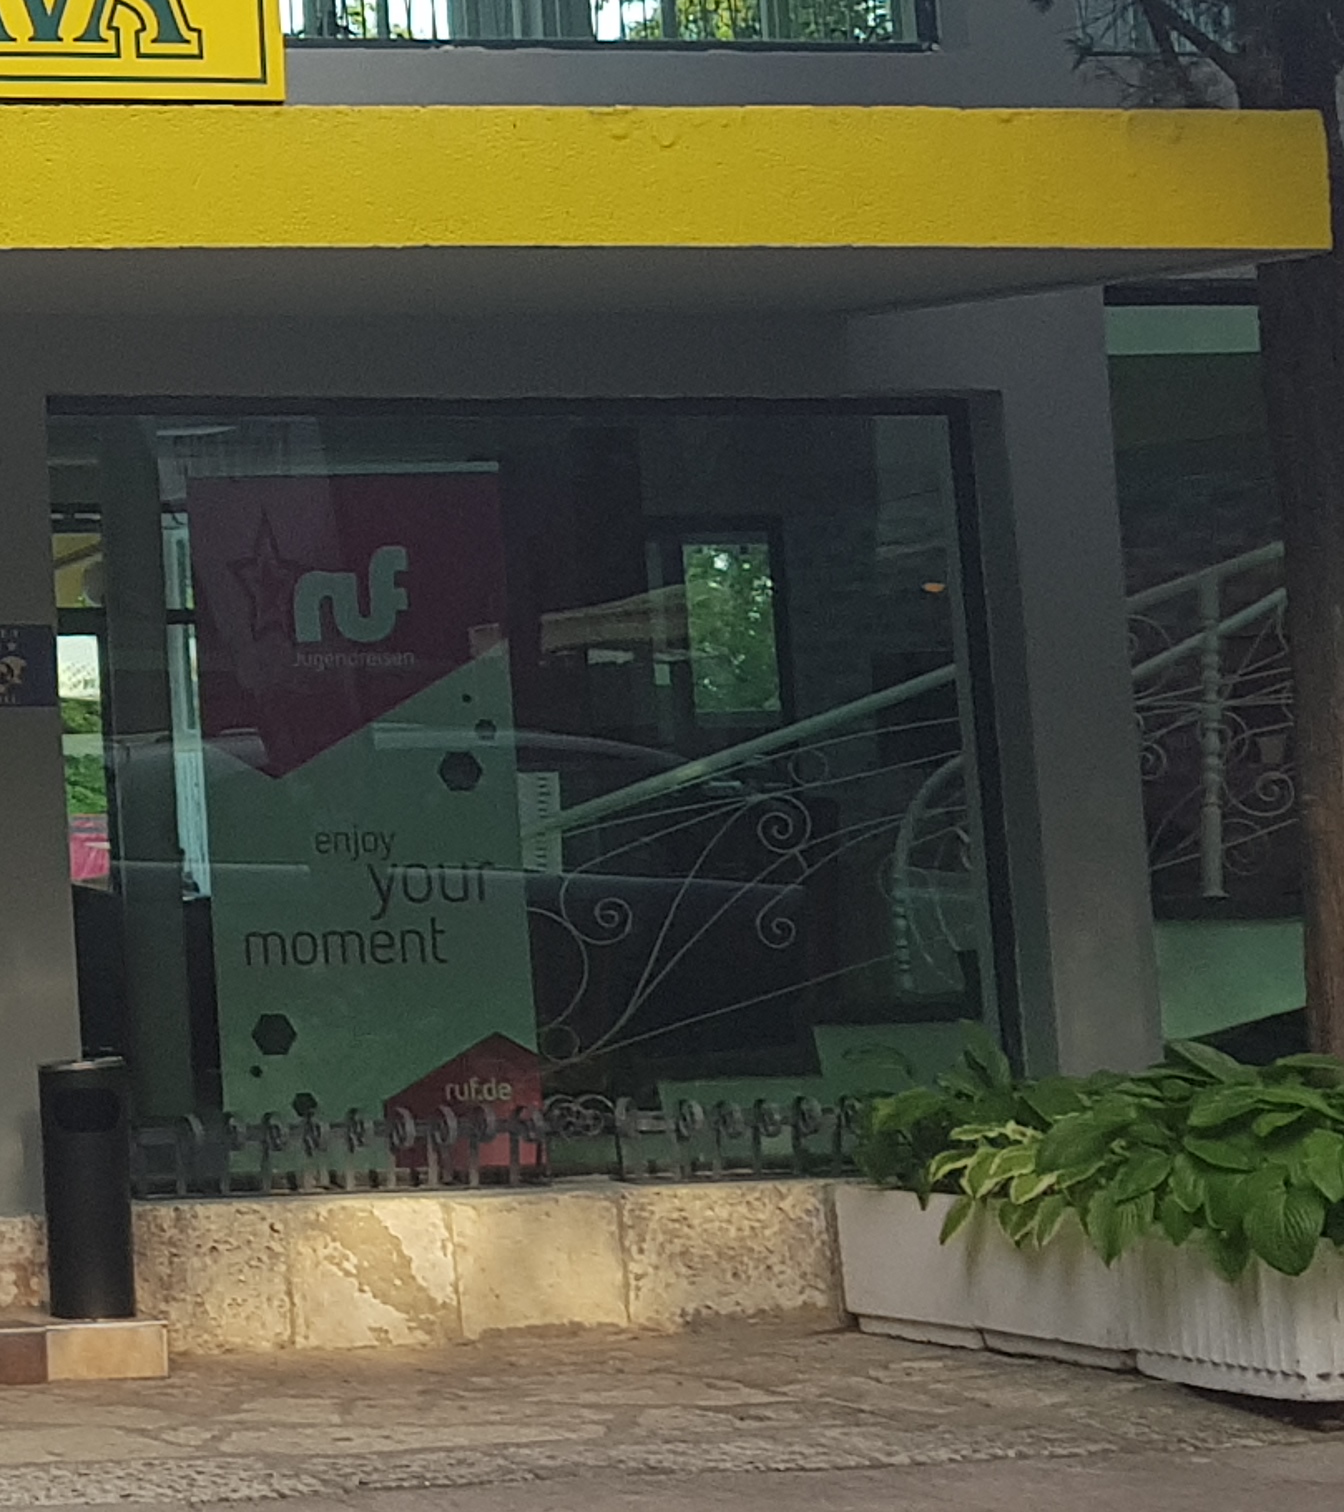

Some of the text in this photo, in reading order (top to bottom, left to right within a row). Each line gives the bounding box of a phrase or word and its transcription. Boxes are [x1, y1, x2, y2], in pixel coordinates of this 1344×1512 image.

[294, 544, 409, 644] ruf
[315, 827, 396, 861] enjoy
[366, 859, 491, 920] your
[244, 917, 449, 966] moment
[444, 1076, 513, 1102] ruf.de
